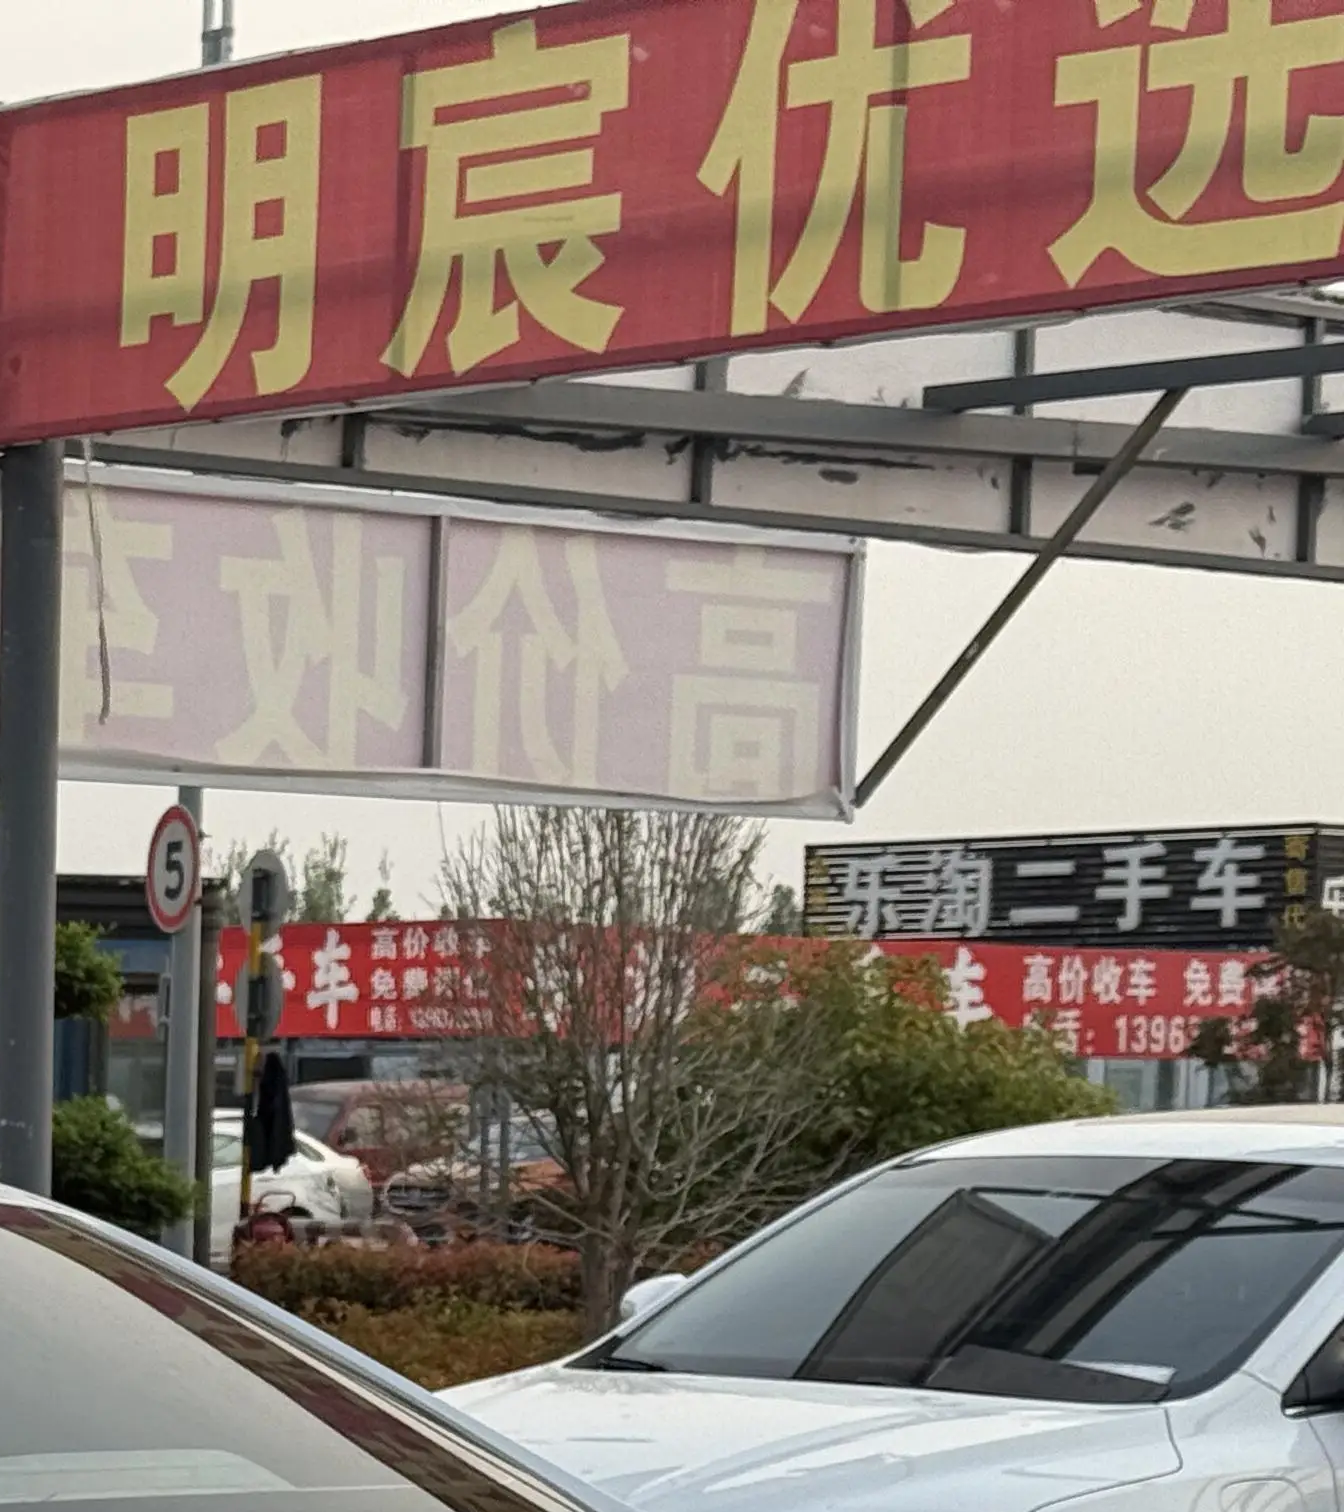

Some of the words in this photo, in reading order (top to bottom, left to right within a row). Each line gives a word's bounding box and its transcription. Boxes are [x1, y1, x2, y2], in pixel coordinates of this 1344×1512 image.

[117, 0, 1344, 412] 明宸优选
[164, 841, 185, 900] 5
[1023, 953, 1158, 1006] 高价收车
